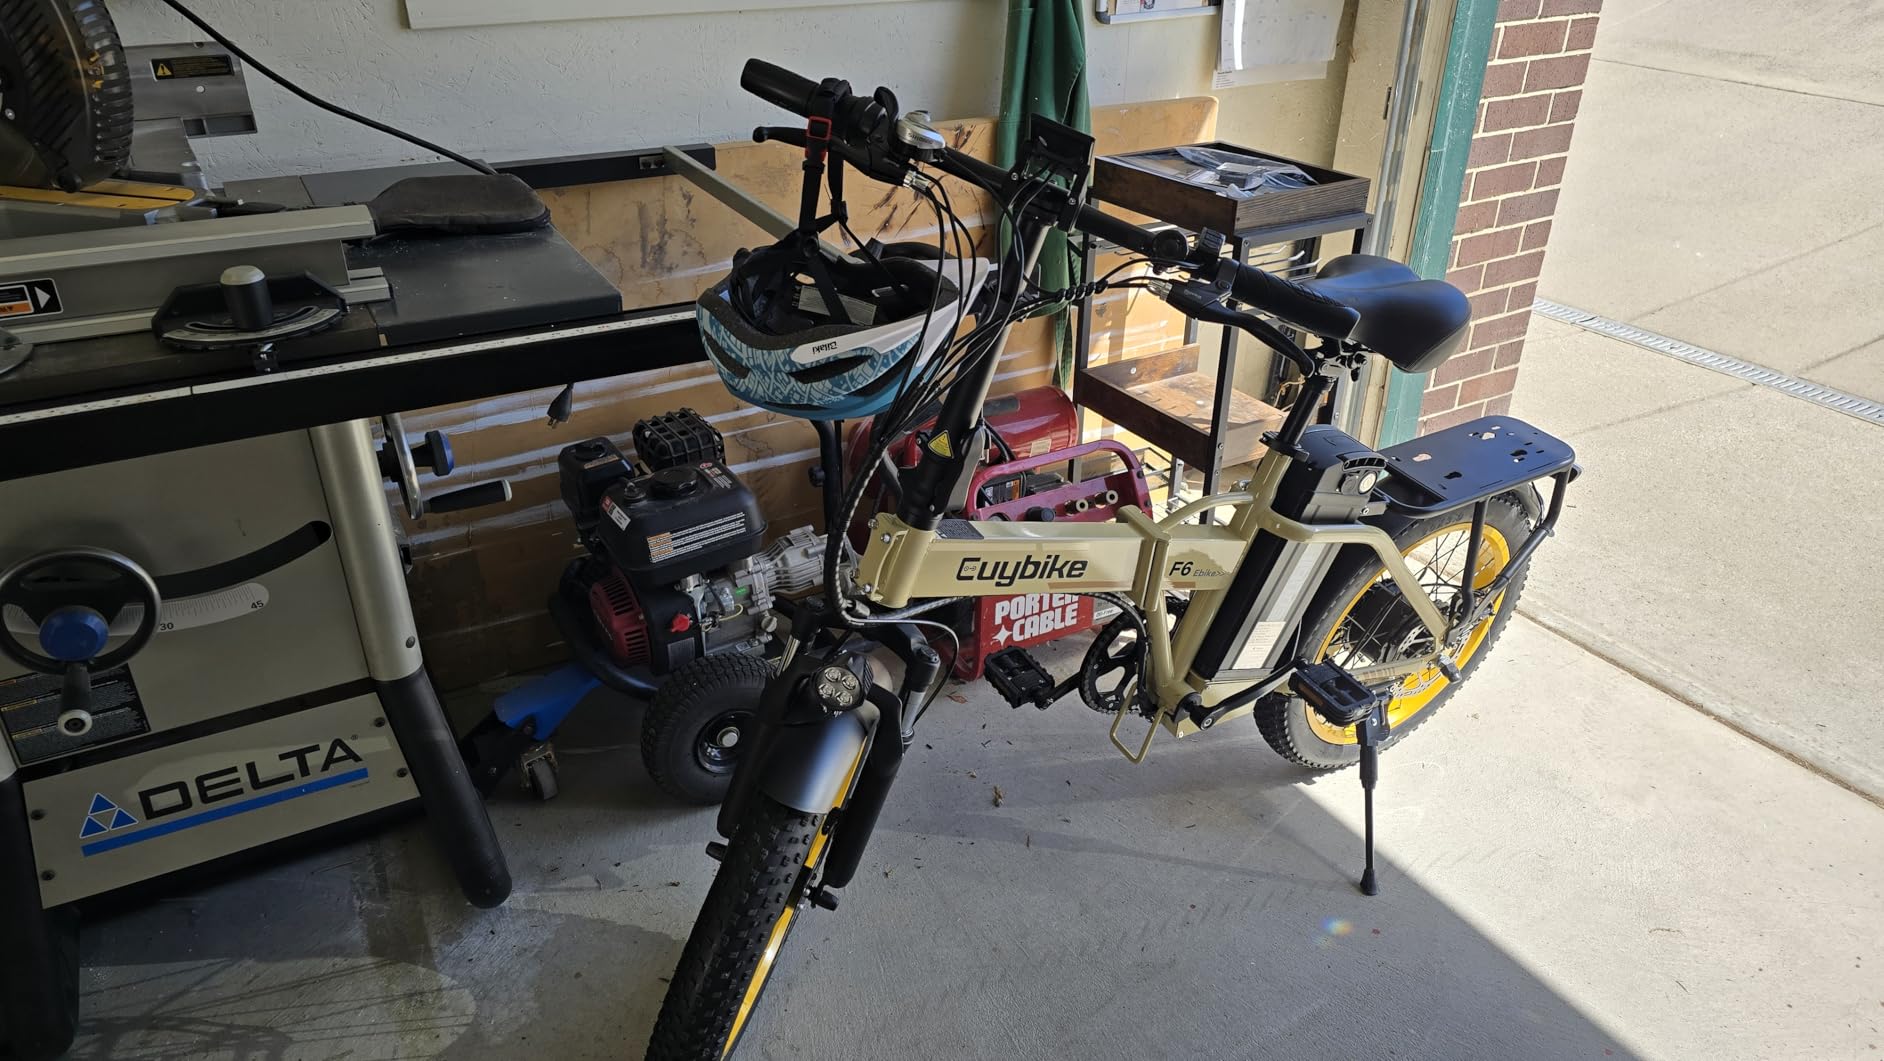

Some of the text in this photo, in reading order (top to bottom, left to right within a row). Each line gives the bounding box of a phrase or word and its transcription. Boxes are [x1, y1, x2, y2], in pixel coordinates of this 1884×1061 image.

[812, 341, 838, 355] Bilaki
[956, 554, 1089, 588] Cuybike
[1169, 561, 1194, 576] F6
[251, 600, 264, 610] 45
[159, 622, 174, 631] 30
[1013, 603, 1079, 642] CABLE
[138, 737, 363, 822] DELTA
